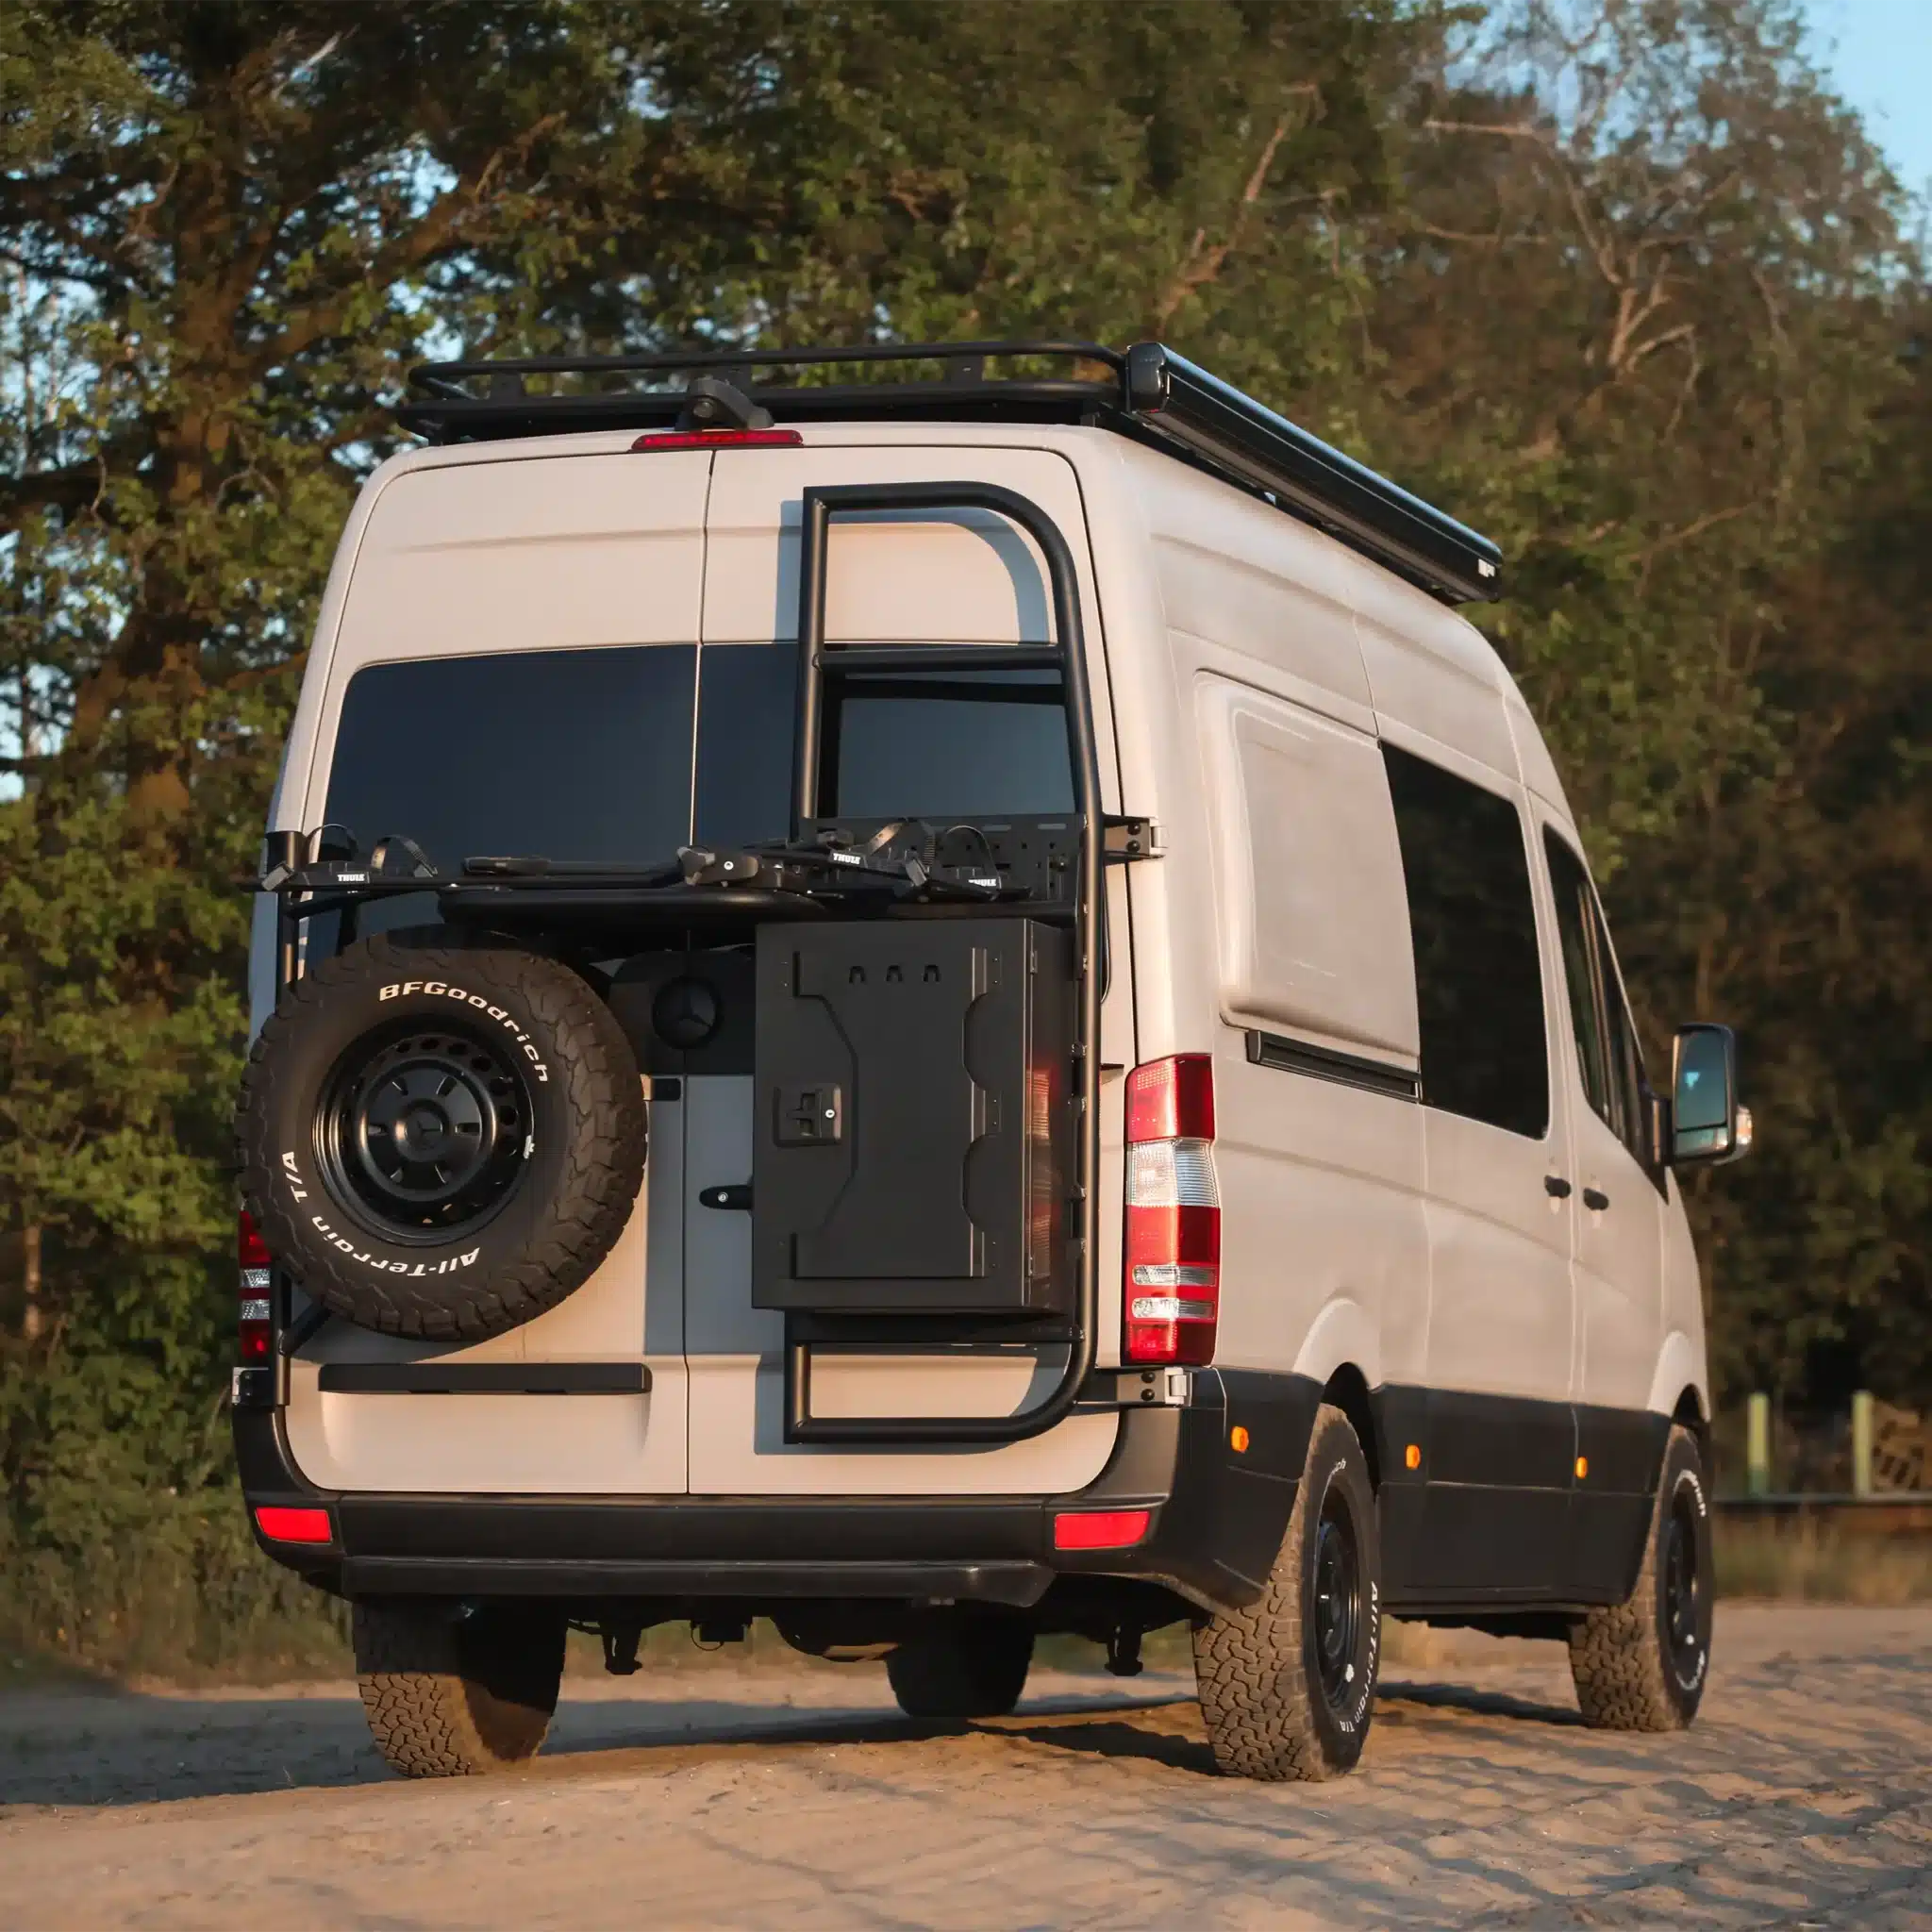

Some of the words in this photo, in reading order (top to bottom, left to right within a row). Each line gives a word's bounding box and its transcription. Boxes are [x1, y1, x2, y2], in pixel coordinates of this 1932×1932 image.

[337, 874, 365, 882] THULE
[833, 853, 861, 865] THULE
[379, 981, 548, 1082] BFGoodrich
[282, 1152, 308, 1204] T/A
[311, 1216, 480, 1276] All-Terrain
